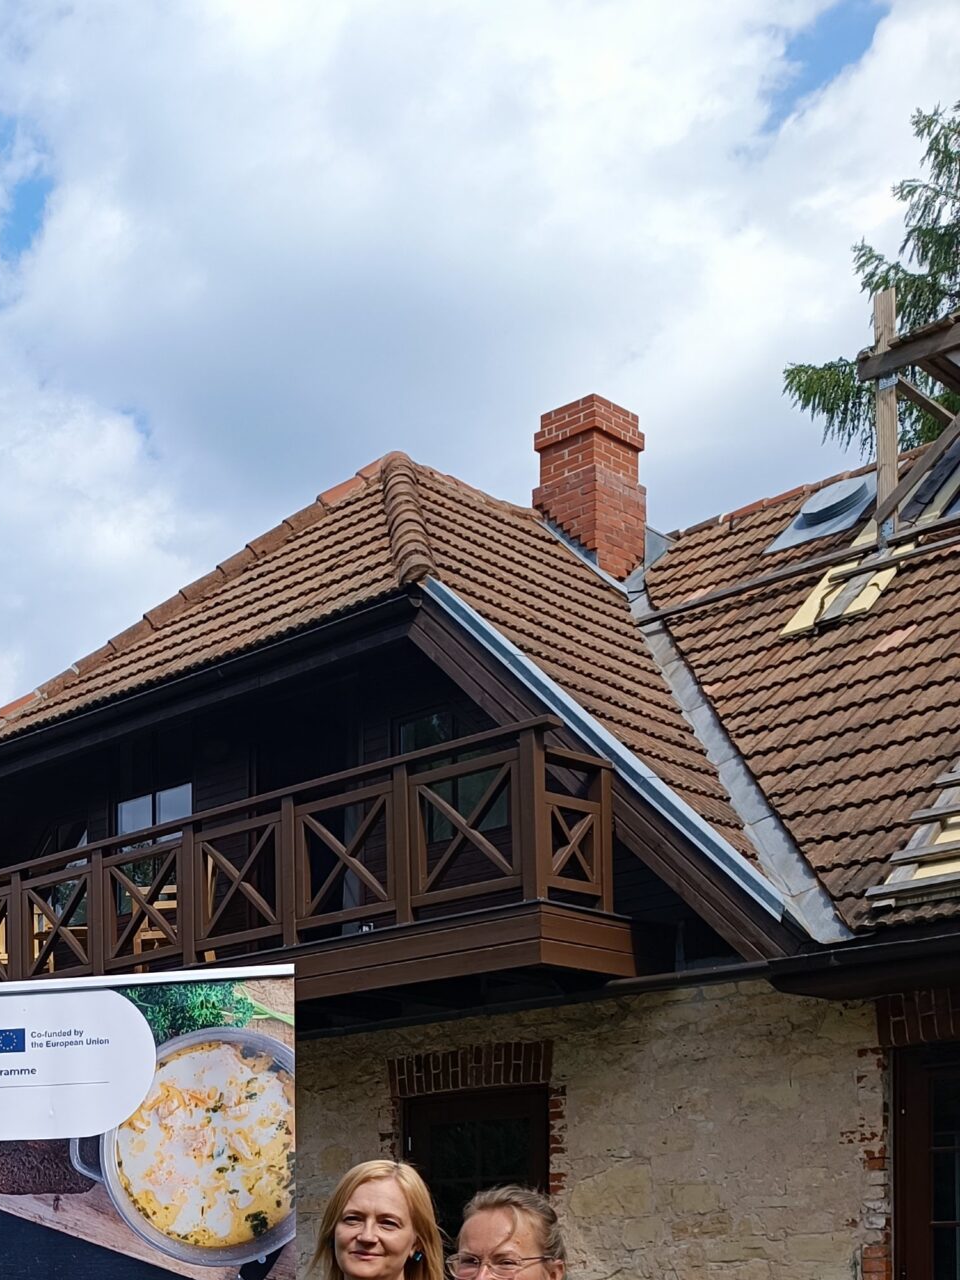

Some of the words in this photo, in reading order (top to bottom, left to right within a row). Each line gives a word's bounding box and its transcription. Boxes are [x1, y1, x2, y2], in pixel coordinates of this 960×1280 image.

[30, 1029, 71, 1039] Co-funded
[74, 1029, 84, 1038] by
[31, 1041, 44, 1049] the
[45, 1039, 84, 1049] European
[86, 1037, 109, 1046] Union
